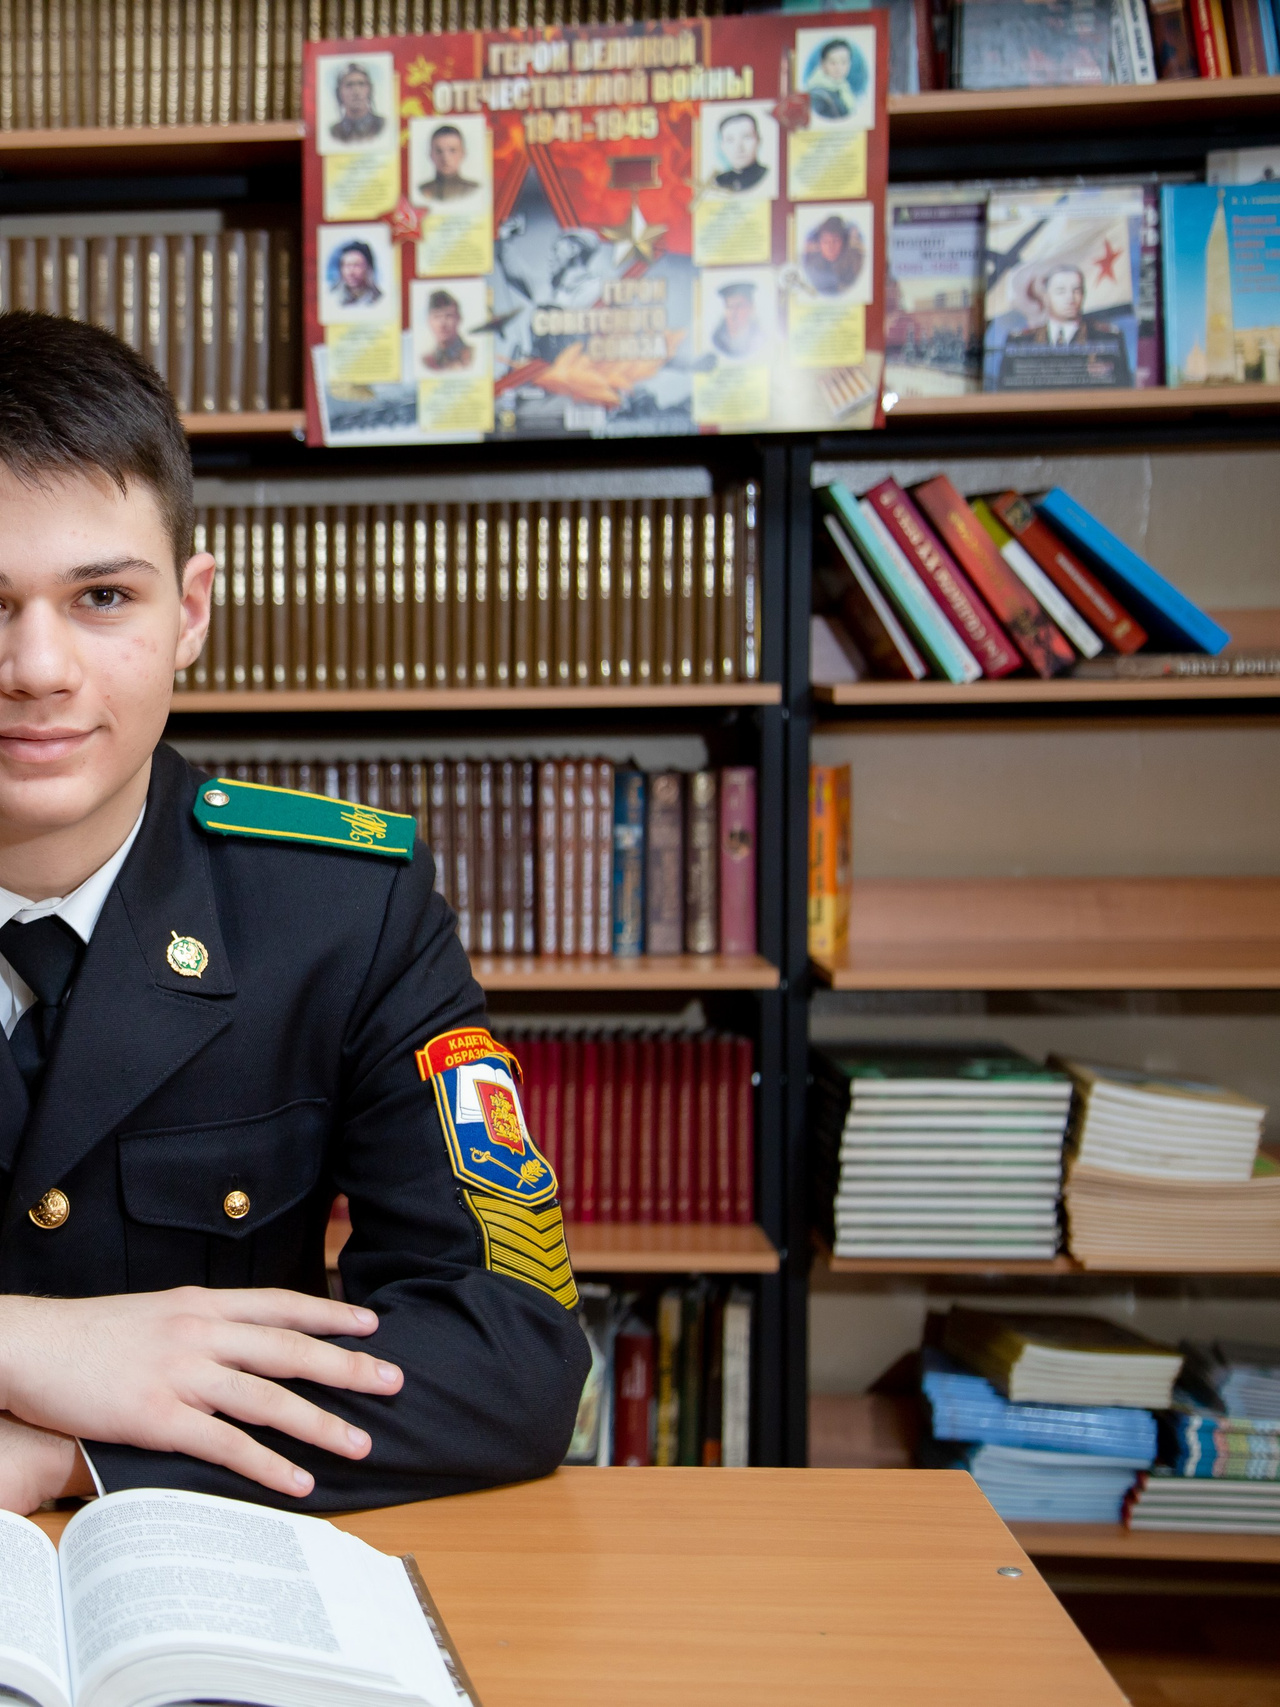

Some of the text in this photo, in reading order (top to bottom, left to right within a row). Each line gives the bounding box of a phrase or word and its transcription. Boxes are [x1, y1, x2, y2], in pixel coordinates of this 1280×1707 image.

[488, 29, 697, 75] ГЕРОИ ВЕЛИКОЙ
[432, 63, 754, 113] ОТЕЧЕСТВЕННОЙ ВОЙНЫ
[524, 107, 659, 144] 1941-1945
